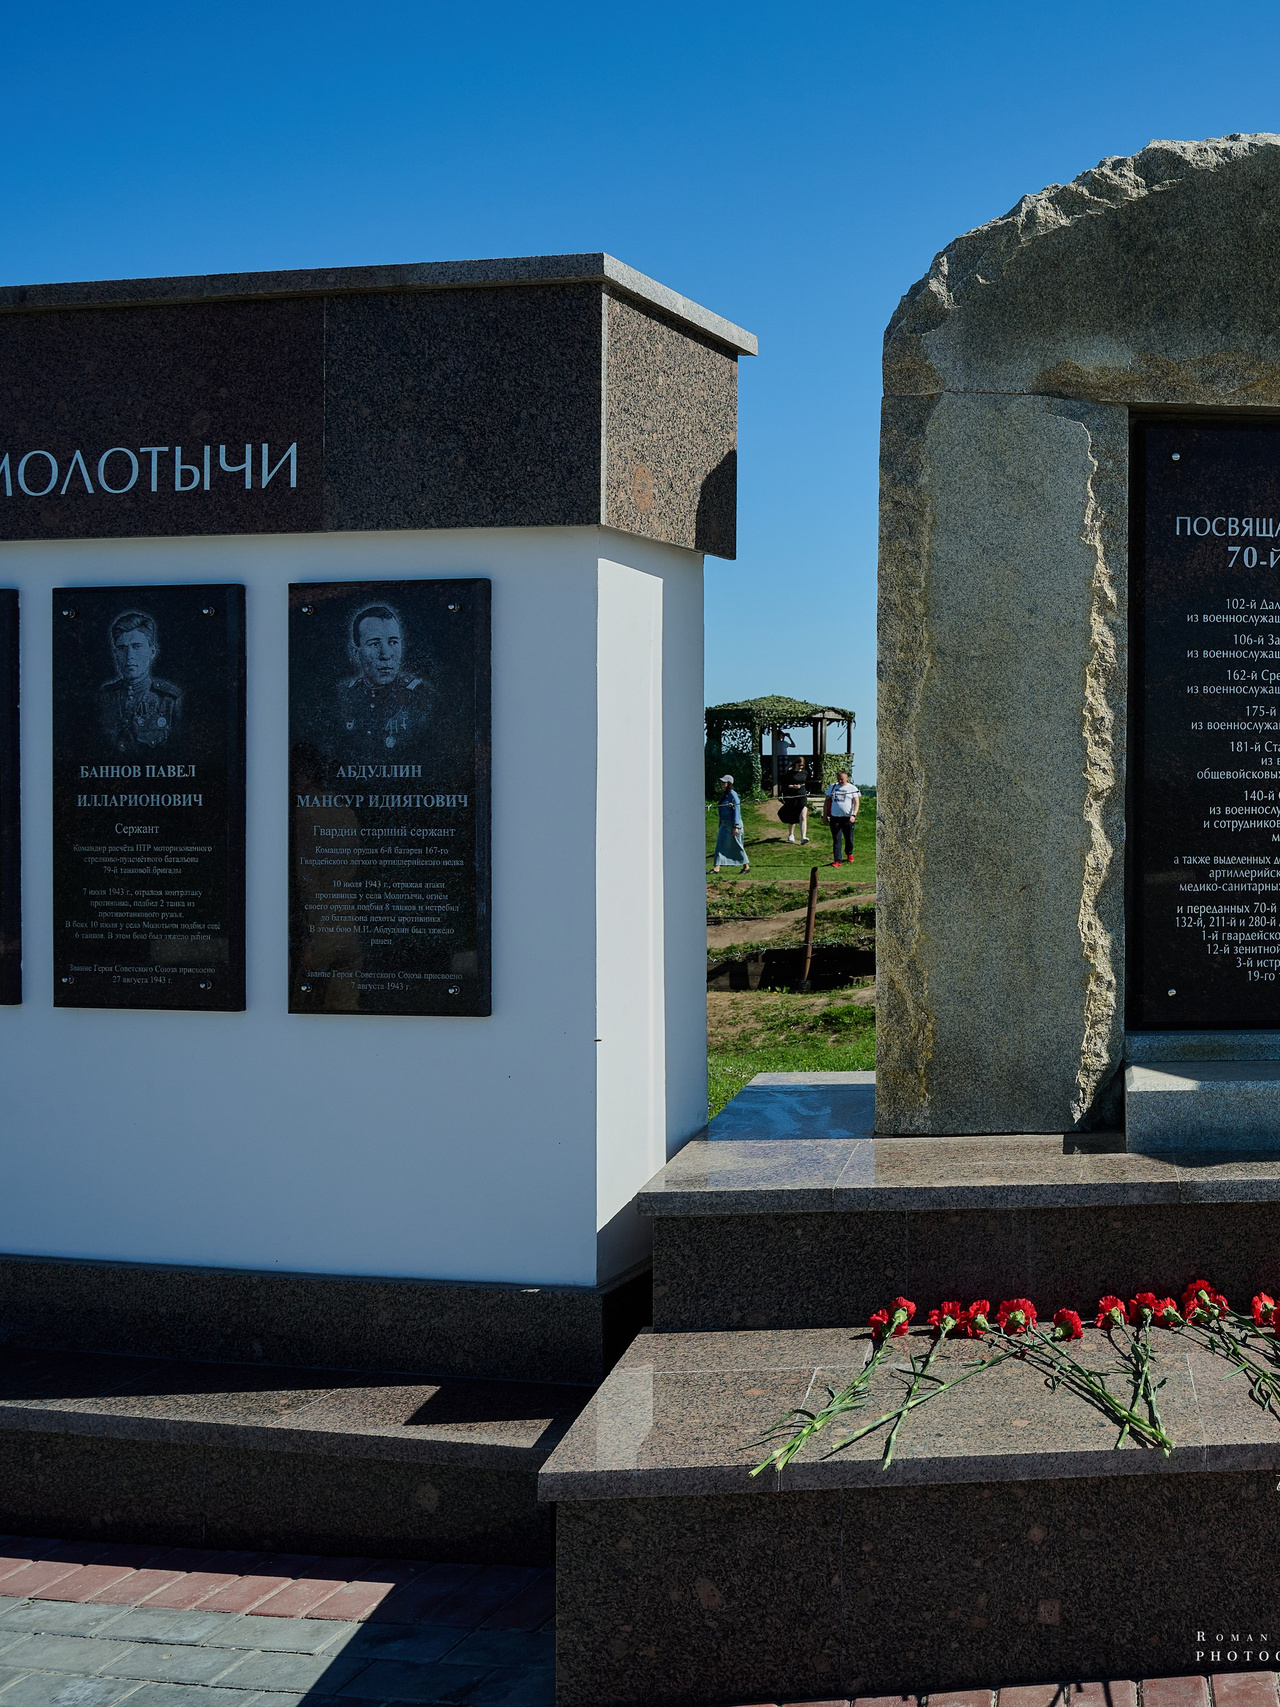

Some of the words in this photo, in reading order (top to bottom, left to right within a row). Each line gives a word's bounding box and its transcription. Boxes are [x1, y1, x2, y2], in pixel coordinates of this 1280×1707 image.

[1226, 598, 1256, 609] 102-й
[1187, 614, 1198, 622] из
[1233, 634, 1263, 644] 106-й
[1187, 650, 1198, 658] из
[1227, 670, 1257, 680] 162-й
[1187, 686, 1198, 694] из
[1246, 705, 1276, 716] 175-й
[1230, 741, 1260, 752] 181-й
[1261, 757, 1272, 765] из
[80, 765, 141, 777] БАННОВ
[145, 764, 195, 777] ПАВЕЛ
[336, 764, 421, 779] АБДУЛЛИН
[77, 794, 202, 806] ИЛЛАРИОНОВИЧ
[1244, 790, 1274, 800] 140-й
[296, 794, 363, 807] МАНСУР
[368, 794, 468, 809] ИДИЯТОВИЧ
[1209, 806, 1221, 814] из
[114, 823, 159, 836] Сержант
[1203, 820, 1209, 828] и
[313, 825, 356, 838] Гвардии
[360, 825, 406, 838] старший
[410, 828, 456, 838] сержант
[1173, 856, 1178, 864] а
[1182, 856, 1210, 864] также
[1213, 855, 1270, 864] выделенных
[1177, 905, 1183, 913] и
[1187, 904, 1249, 915] переданных
[1253, 902, 1276, 912] 70-й
[1176, 916, 1205, 929] 132-й,
[1209, 916, 1236, 926] 211-й
[1239, 918, 1245, 926] и
[1248, 915, 1275, 926] 280-й
[1202, 929, 1218, 940] 1-й
[1207, 943, 1229, 954] 12-й
[1236, 957, 1252, 967] 3-й
[1248, 970, 1275, 980] 19-го
